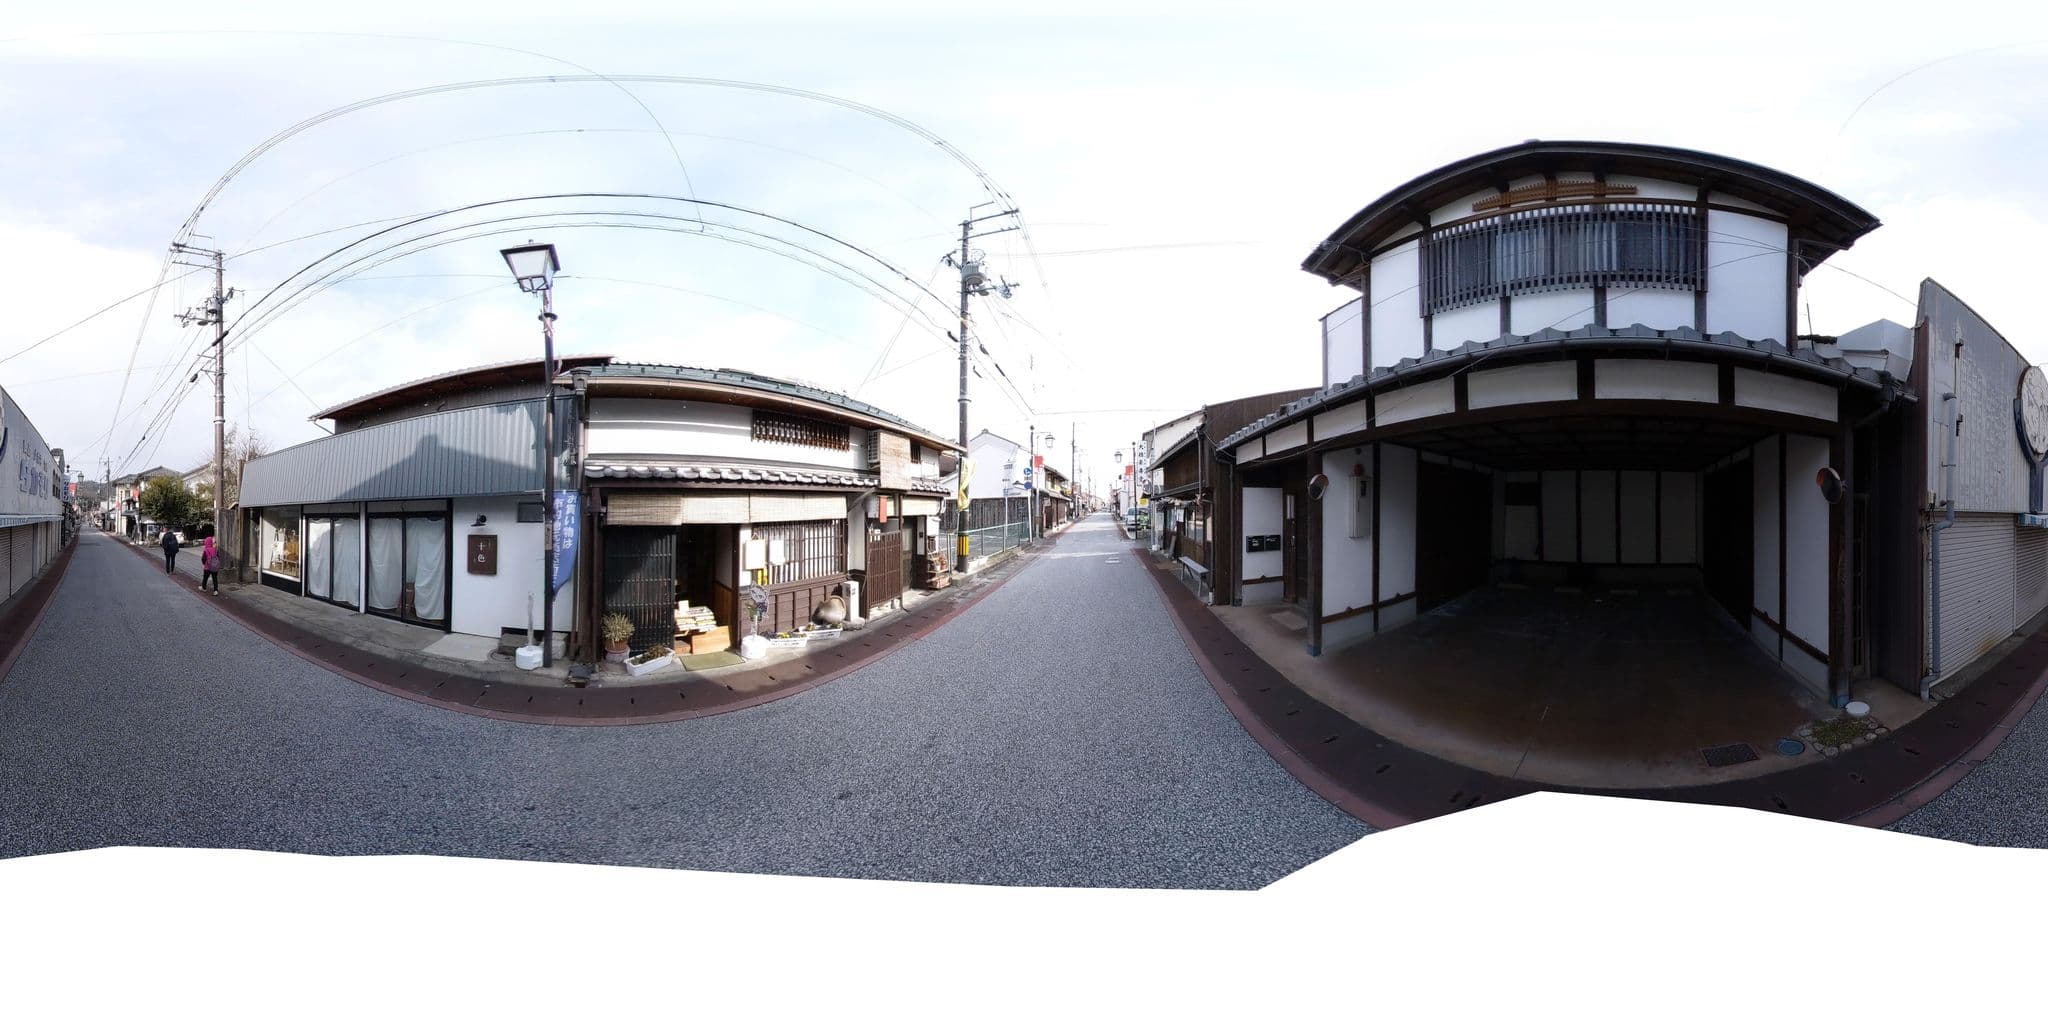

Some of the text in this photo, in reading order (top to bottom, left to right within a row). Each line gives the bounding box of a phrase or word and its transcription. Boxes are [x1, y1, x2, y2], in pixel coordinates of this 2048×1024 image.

[563, 495, 577, 549] お買い物は
